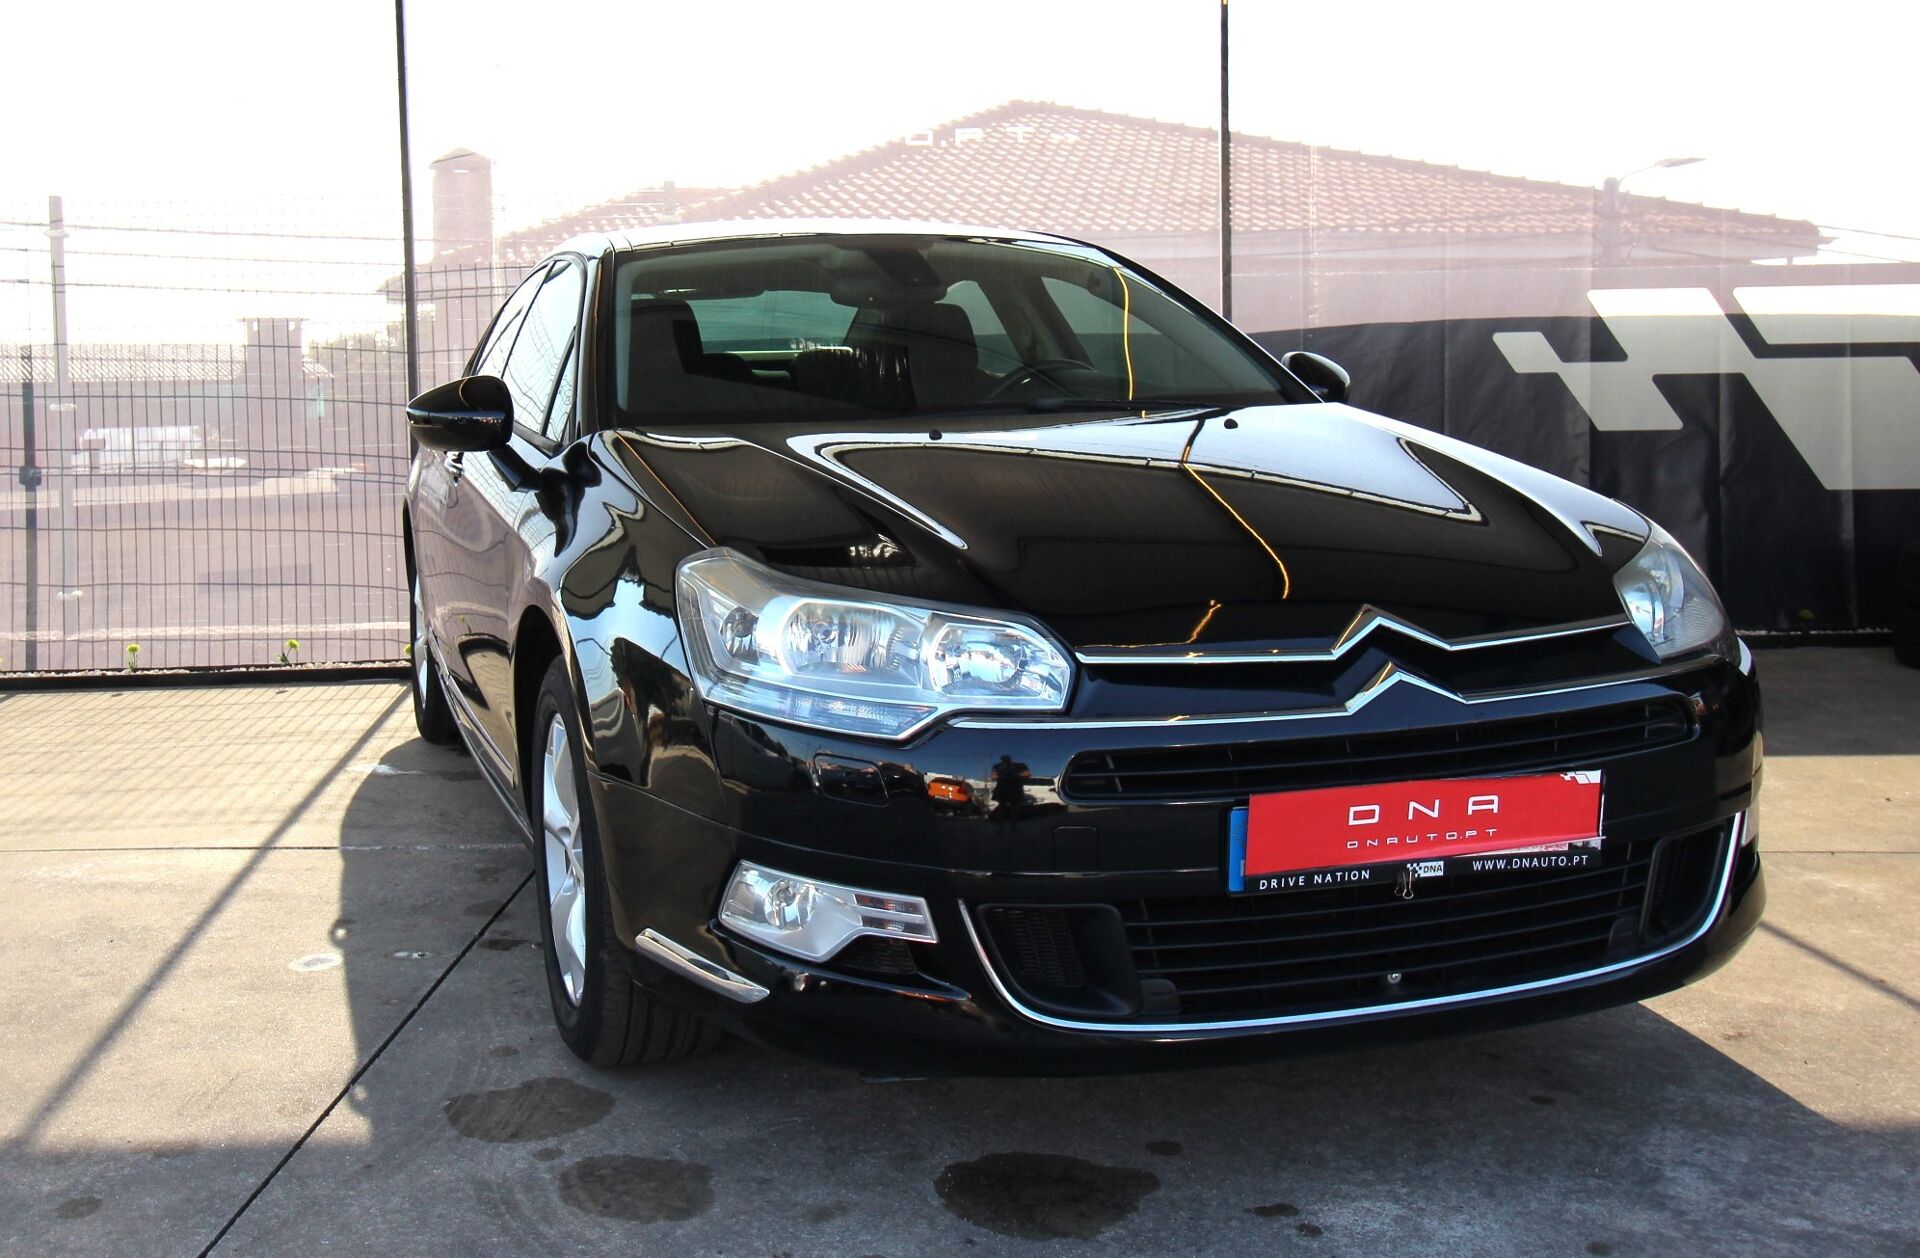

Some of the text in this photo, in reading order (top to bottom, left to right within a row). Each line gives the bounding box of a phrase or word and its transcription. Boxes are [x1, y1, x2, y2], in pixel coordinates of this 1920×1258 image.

[1348, 794, 1499, 826] DNA
[1423, 863, 1443, 874] DNA
[1472, 855, 1589, 871] WWW.DNAUTO.PT
[1258, 869, 1370, 890] DRIVE NATION
